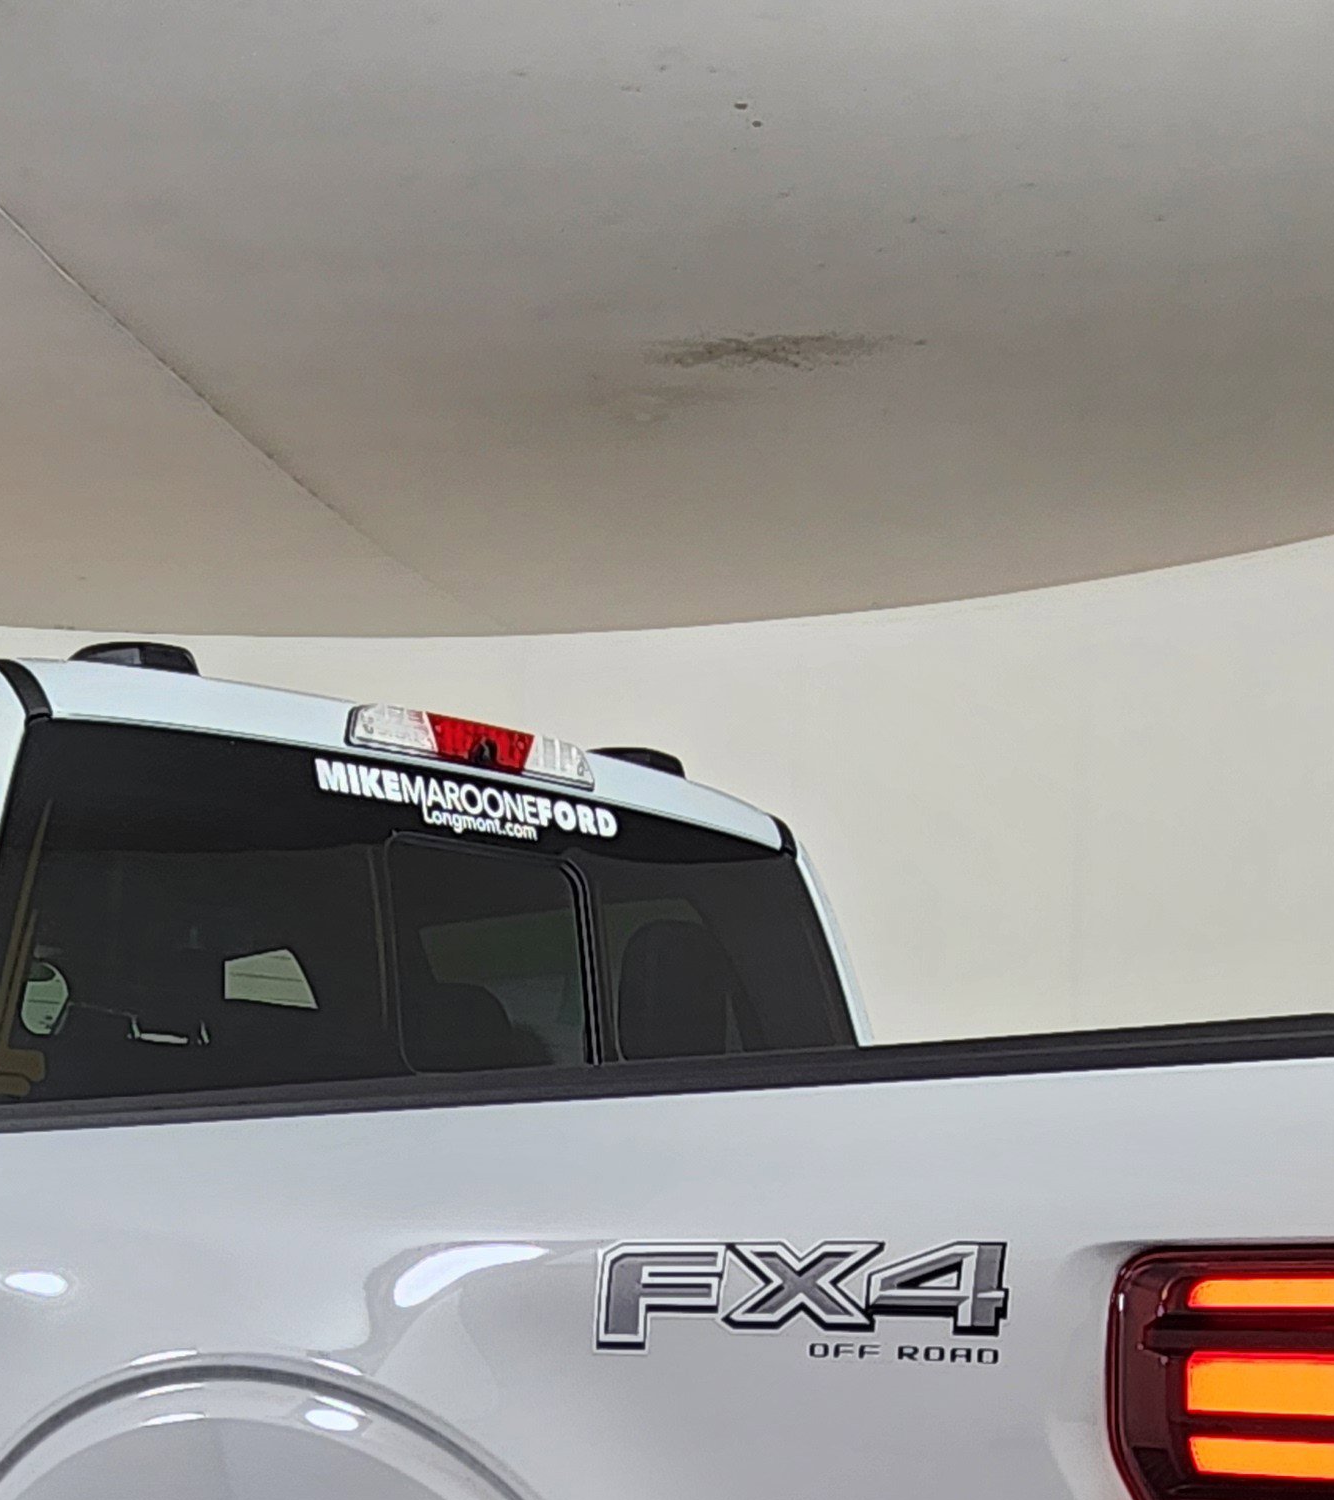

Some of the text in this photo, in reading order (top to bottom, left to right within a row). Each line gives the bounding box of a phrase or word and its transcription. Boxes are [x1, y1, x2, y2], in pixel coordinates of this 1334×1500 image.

[423, 804, 538, 841] Longmont.com
[593, 1239, 1009, 1353] FX4
[807, 1341, 1001, 1365] OFF ROAD
